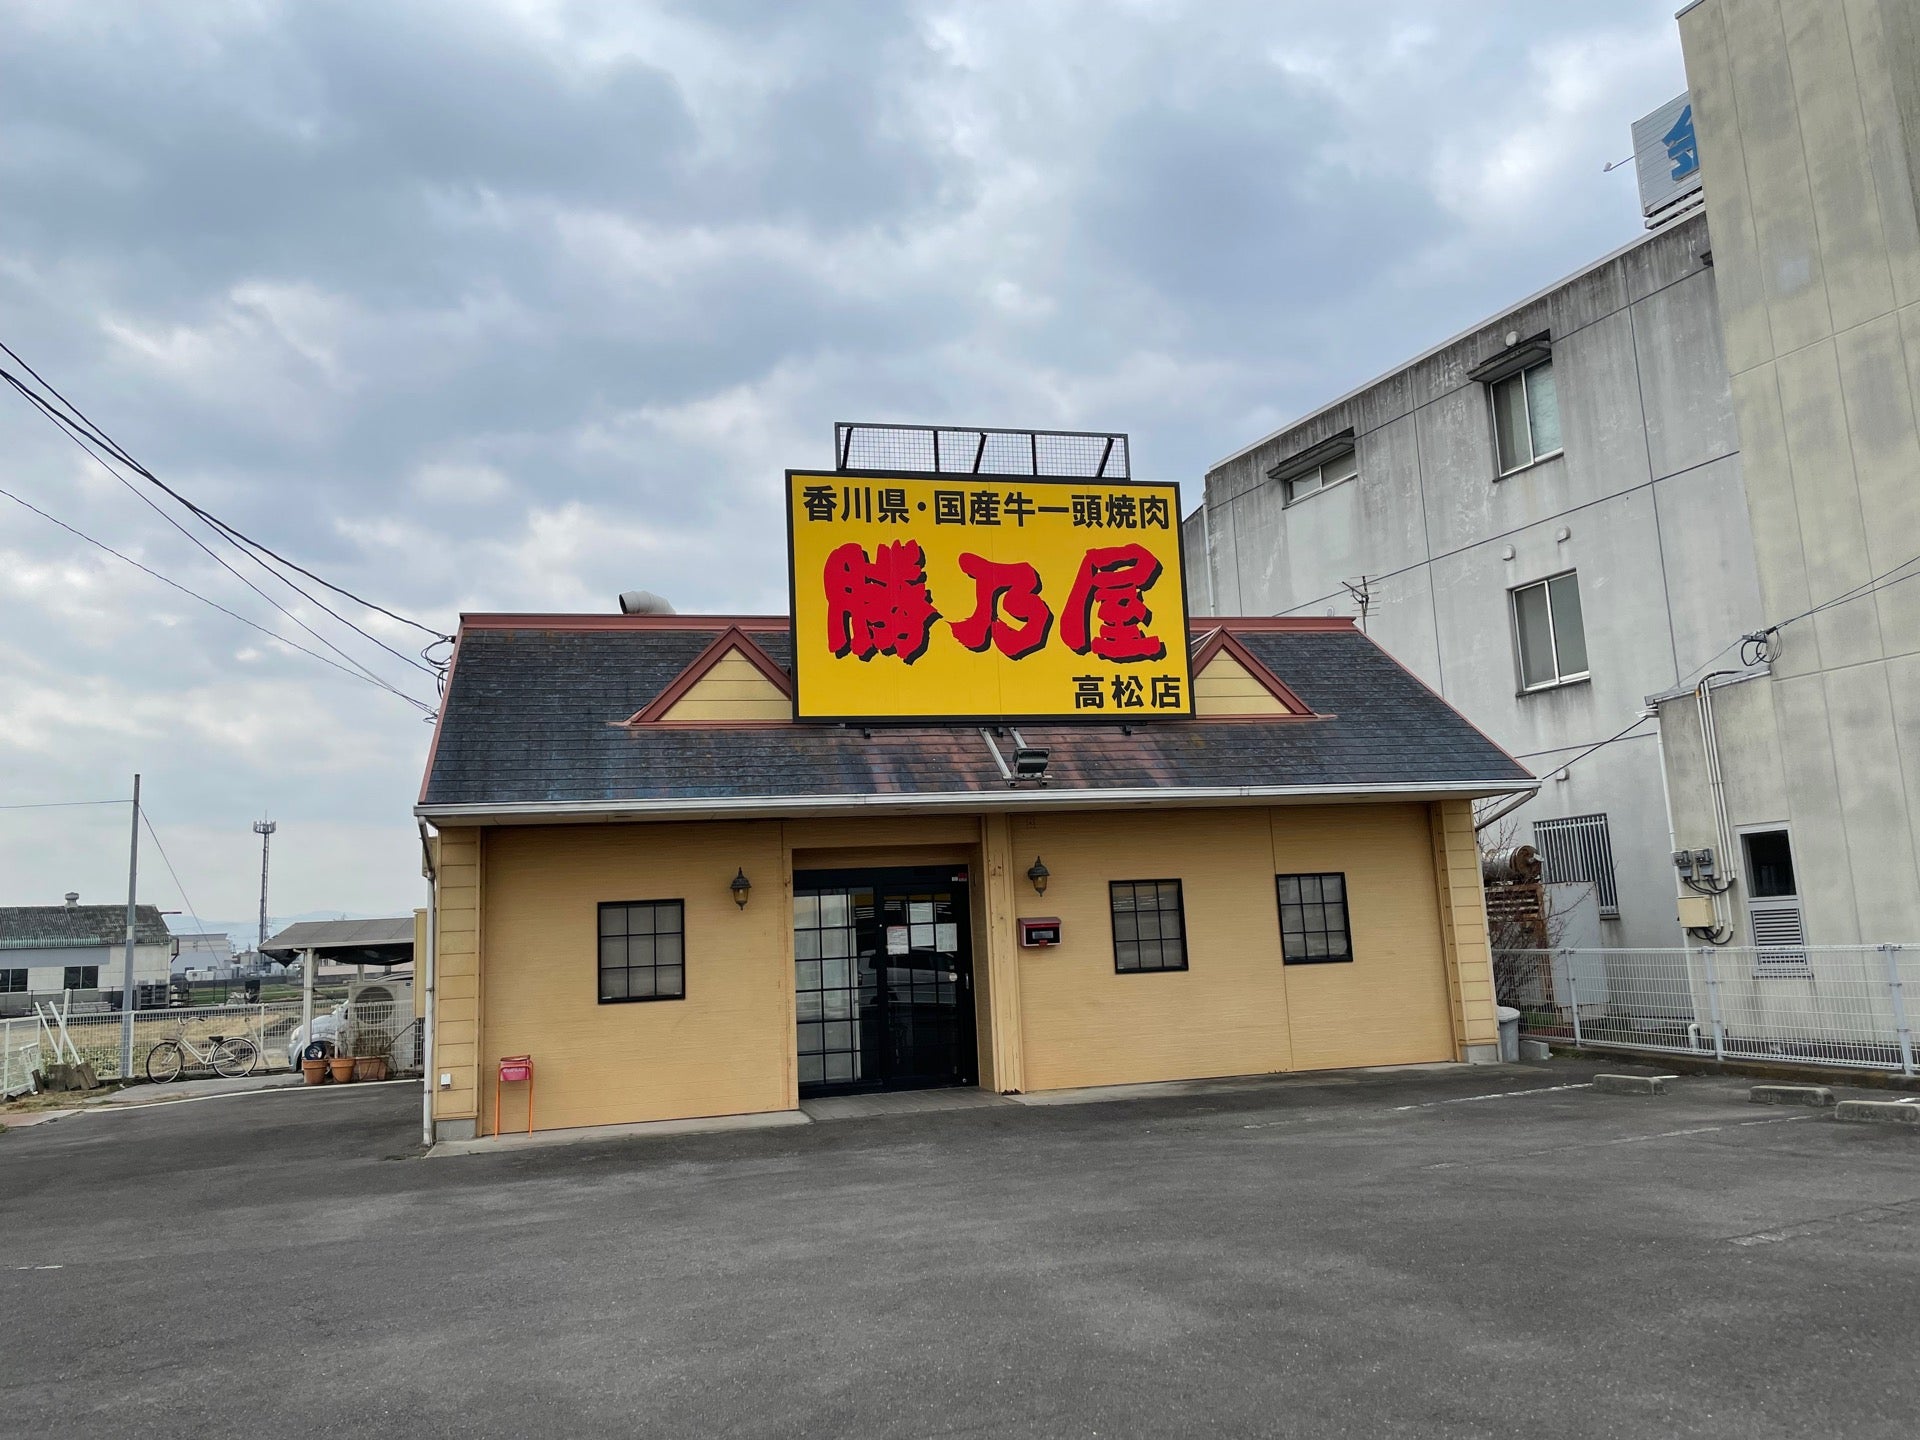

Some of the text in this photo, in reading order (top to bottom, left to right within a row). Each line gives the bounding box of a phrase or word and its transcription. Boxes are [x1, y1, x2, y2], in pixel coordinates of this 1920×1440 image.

[803, 485, 1170, 530] 香川県・国産牛一頭焼肉
[824, 539, 1166, 665] 勝乃屋
[1072, 674, 1181, 709] 高松店
